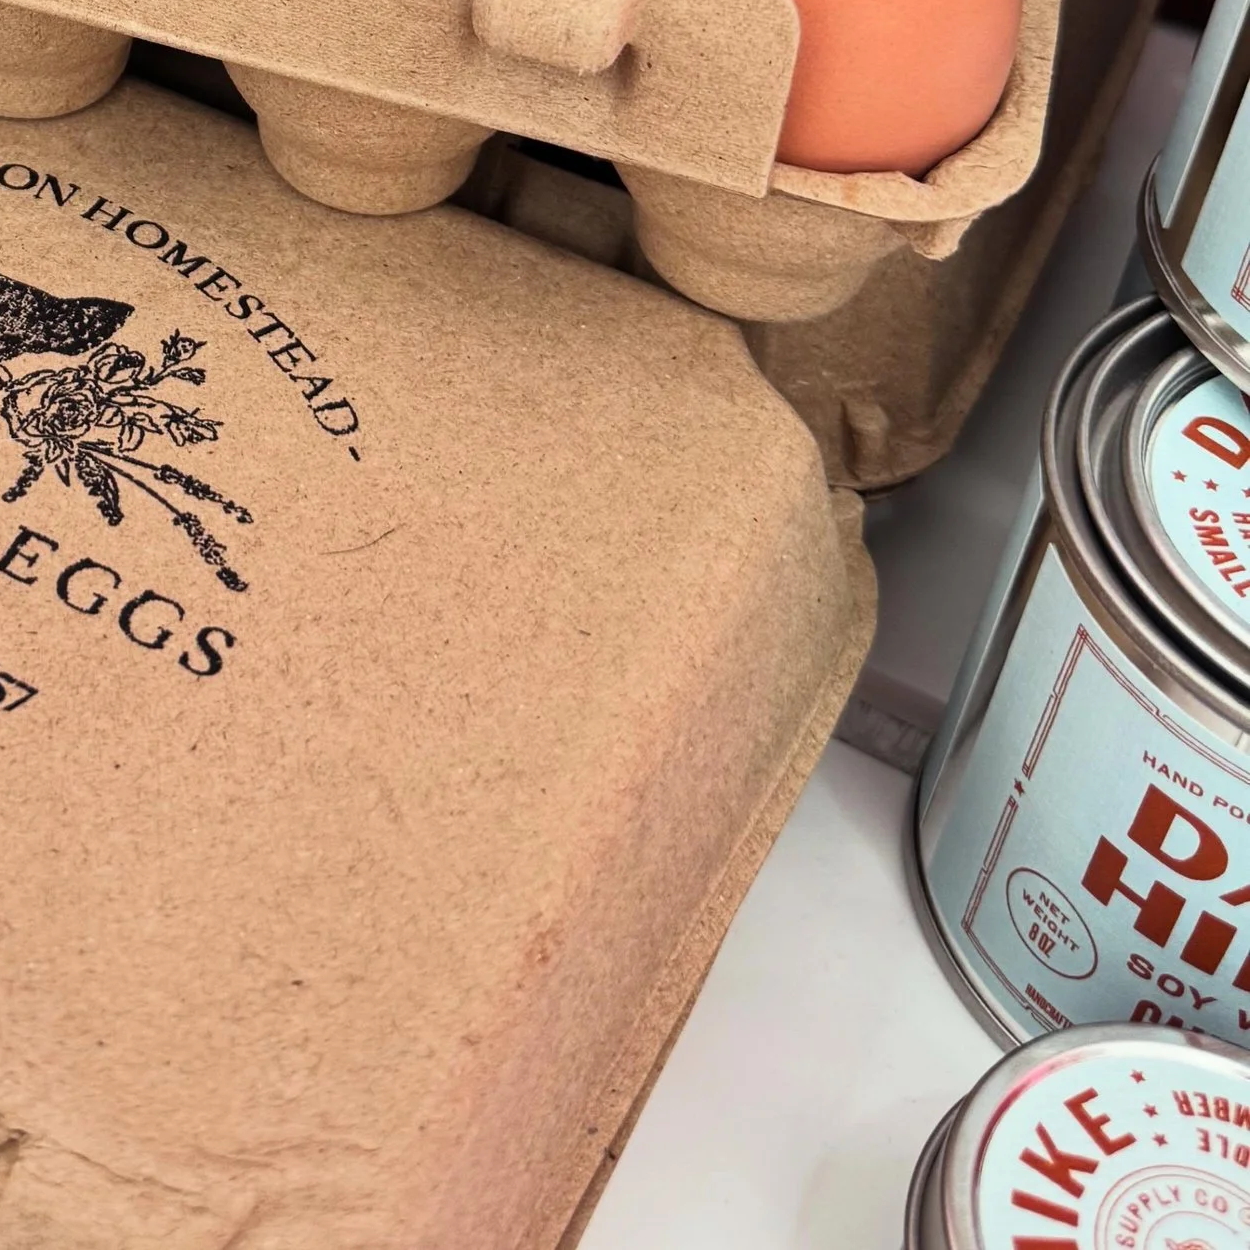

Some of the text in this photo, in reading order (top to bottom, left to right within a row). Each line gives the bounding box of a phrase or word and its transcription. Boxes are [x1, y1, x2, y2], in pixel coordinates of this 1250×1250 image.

[1142, 749, 1250, 826] HAND PO
[1021, 887, 1080, 953] WEIGHT
[1027, 921, 1056, 959] 8 OZ
[1038, 890, 1071, 926] NET
[1080, 834, 1250, 994] HI
[1024, 981, 1076, 1030] HANDCRAFT
[1126, 953, 1218, 1011] SOY
[1010, 1086, 1138, 1250] IKE
[1114, 1184, 1230, 1249] SUPPLY CO
